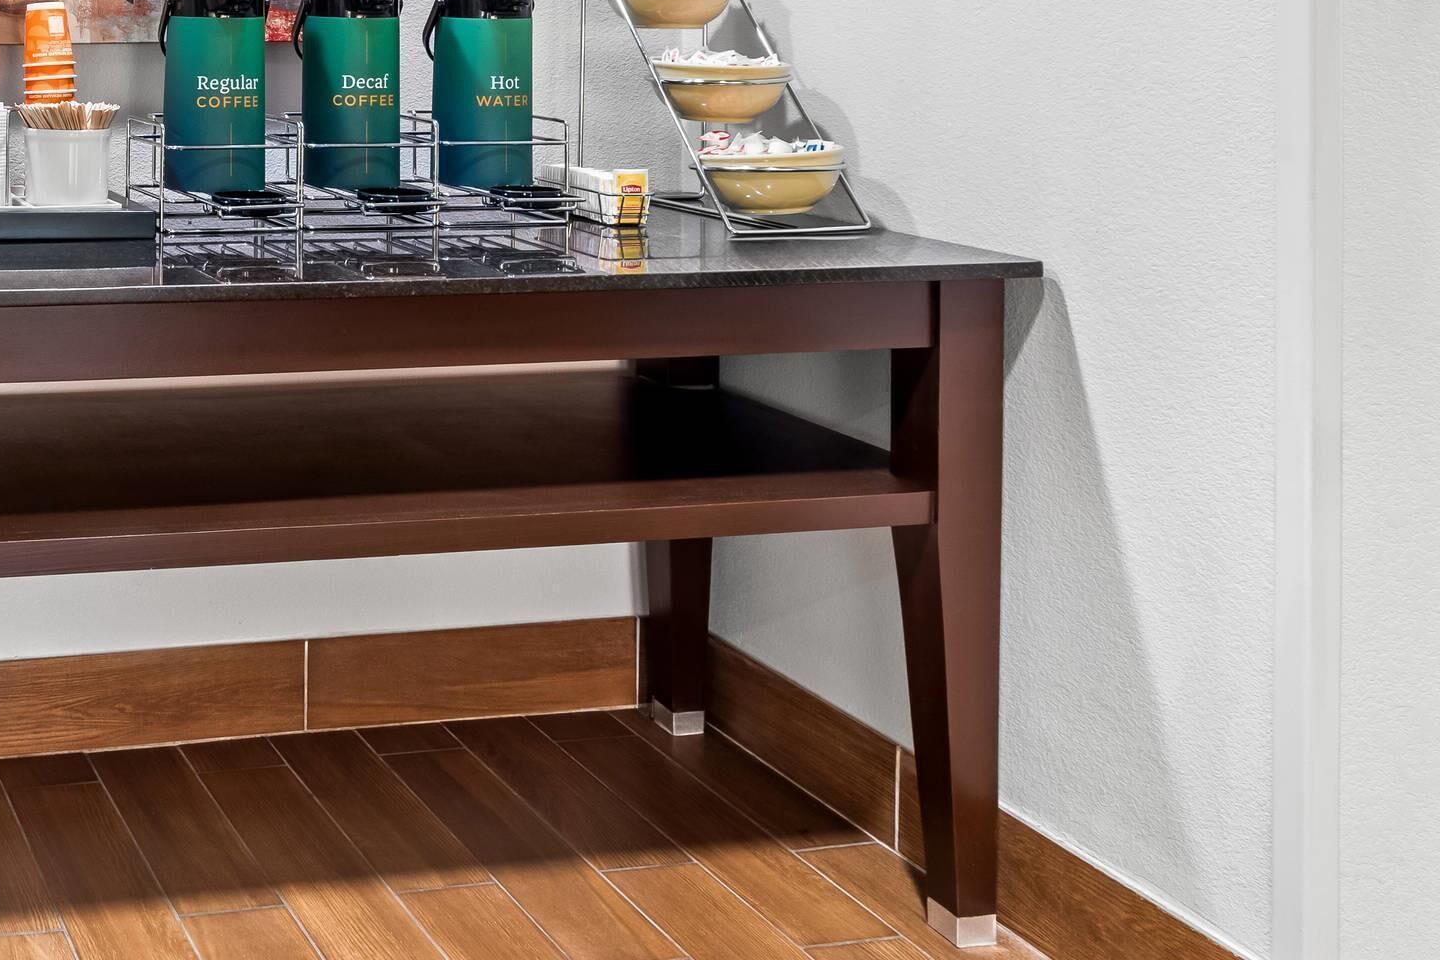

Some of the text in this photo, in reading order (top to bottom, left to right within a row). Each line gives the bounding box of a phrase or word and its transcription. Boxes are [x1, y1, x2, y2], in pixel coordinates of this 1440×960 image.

[196, 74, 259, 94] Regular
[341, 73, 390, 90] Decaf
[490, 75, 521, 90] Hot
[196, 95, 259, 109] COFFEE
[332, 94, 395, 107] COFFEE
[475, 94, 529, 107] WATER
